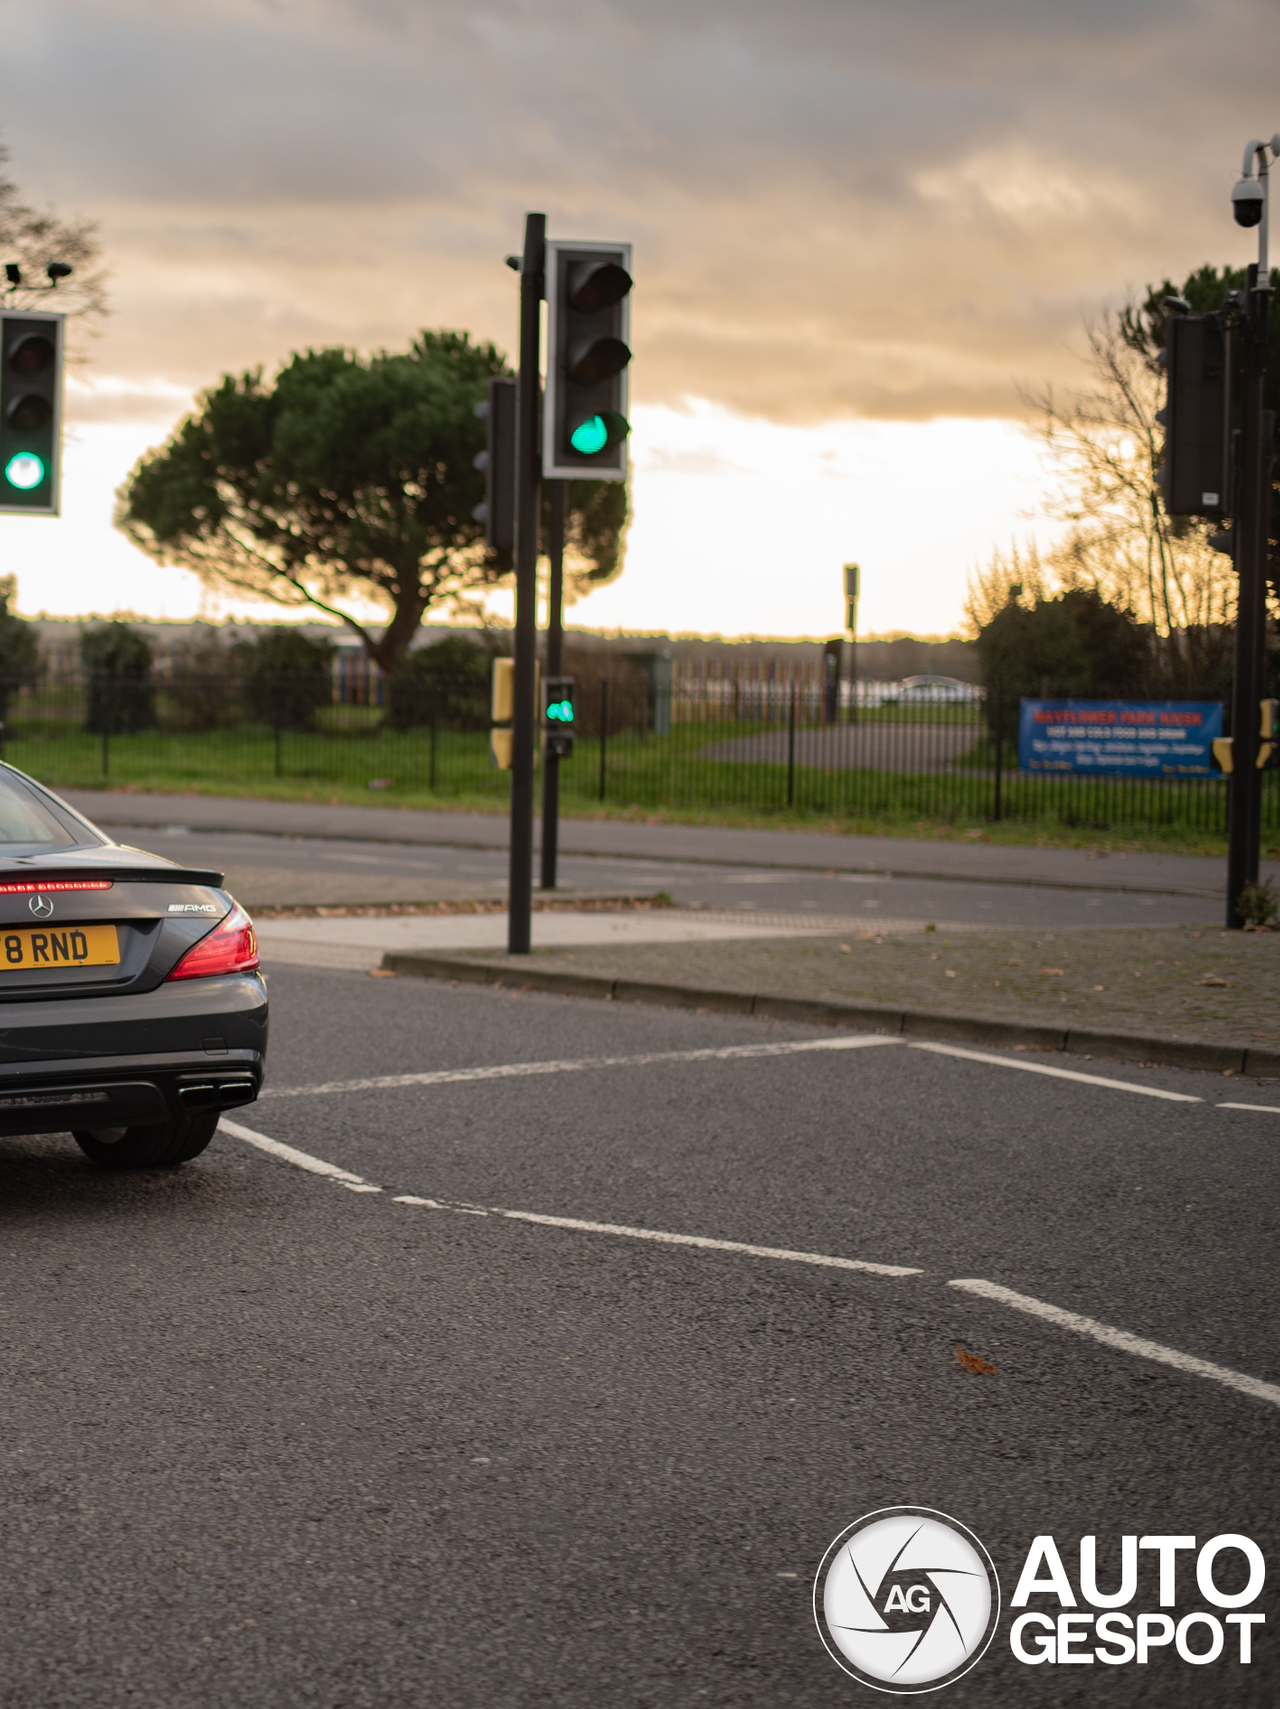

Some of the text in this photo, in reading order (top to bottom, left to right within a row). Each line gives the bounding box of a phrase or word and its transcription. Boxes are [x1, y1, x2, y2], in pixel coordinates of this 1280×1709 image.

[1034, 710, 1203, 726] MAYFLOWER PARK KIOSK
[184, 904, 217, 912] AMG
[31, 931, 89, 963] RND
